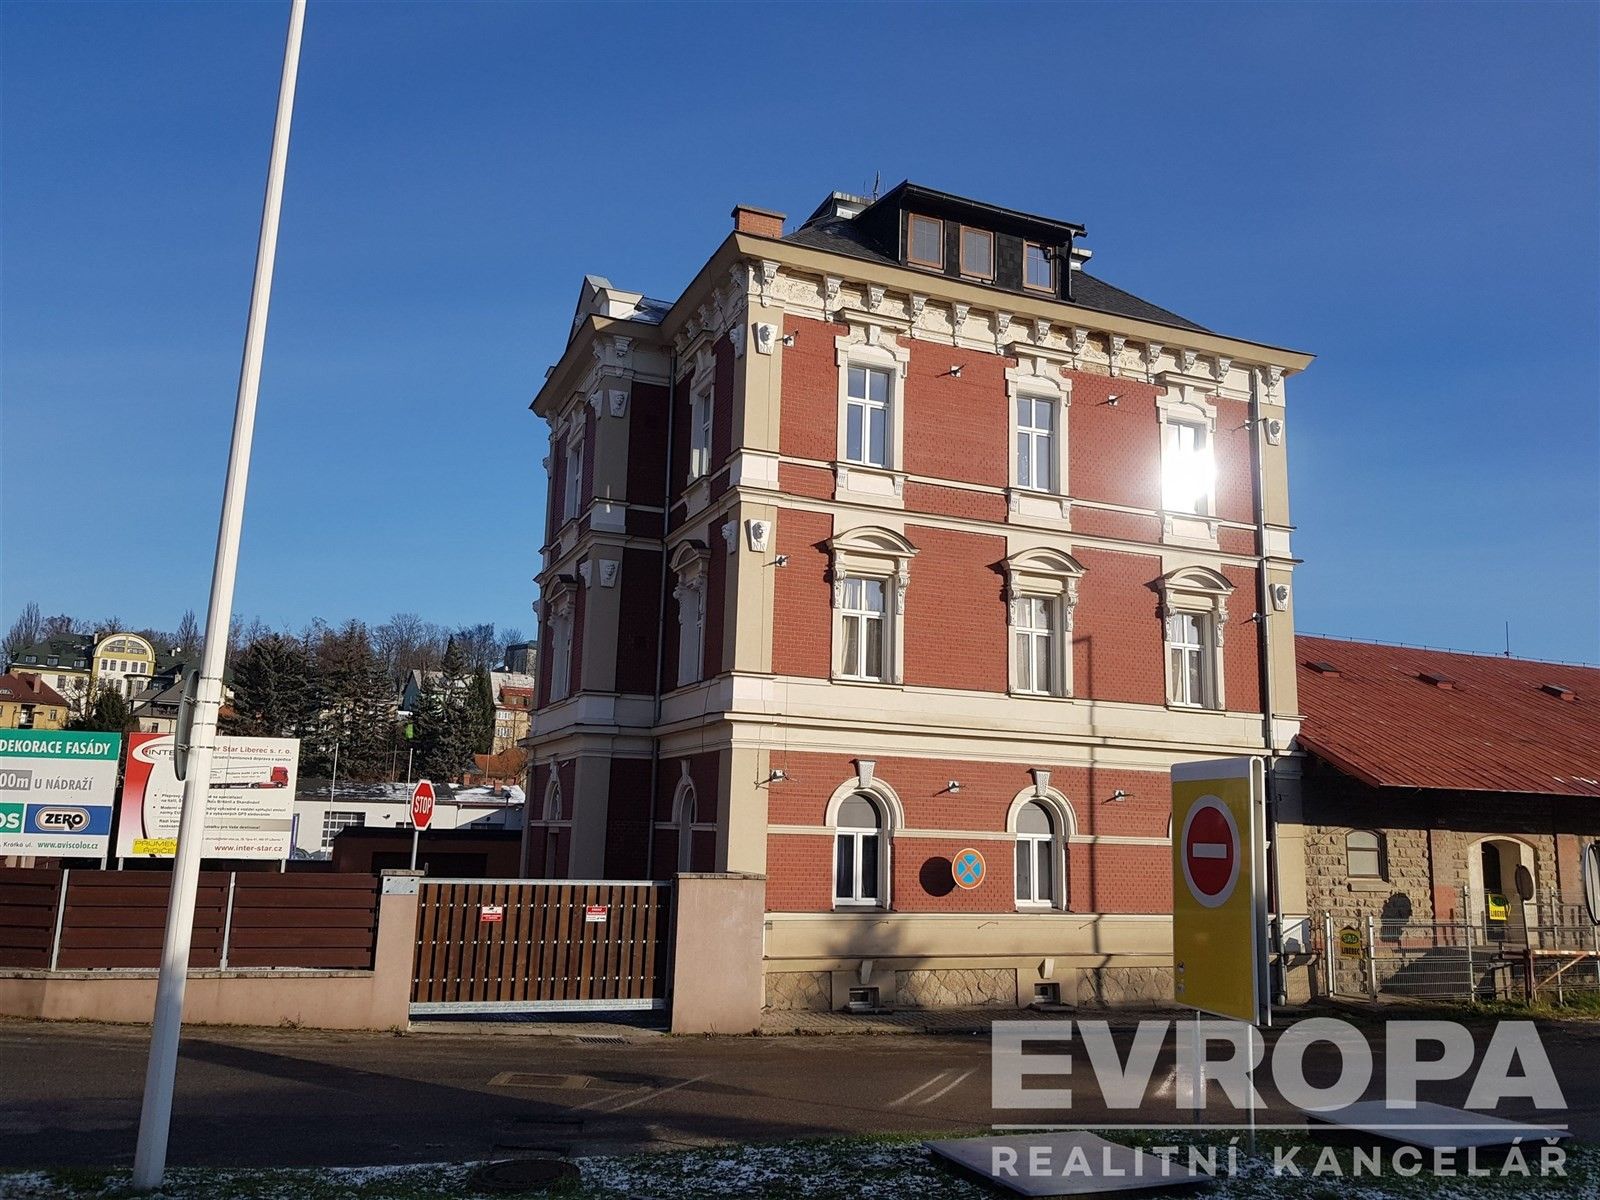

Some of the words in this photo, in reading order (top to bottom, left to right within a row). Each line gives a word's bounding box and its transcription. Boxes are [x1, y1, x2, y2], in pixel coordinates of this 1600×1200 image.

[0, 740, 62, 754] DEKORACE
[66, 739, 111, 755] FASÁDY
[34, 778, 42, 789] U
[45, 776, 94, 791] NÁDRAŽÍ
[414, 796, 432, 814] STOP
[44, 813, 84, 830] ZERO
[37, 840, 98, 850] www.aviscolor.cz
